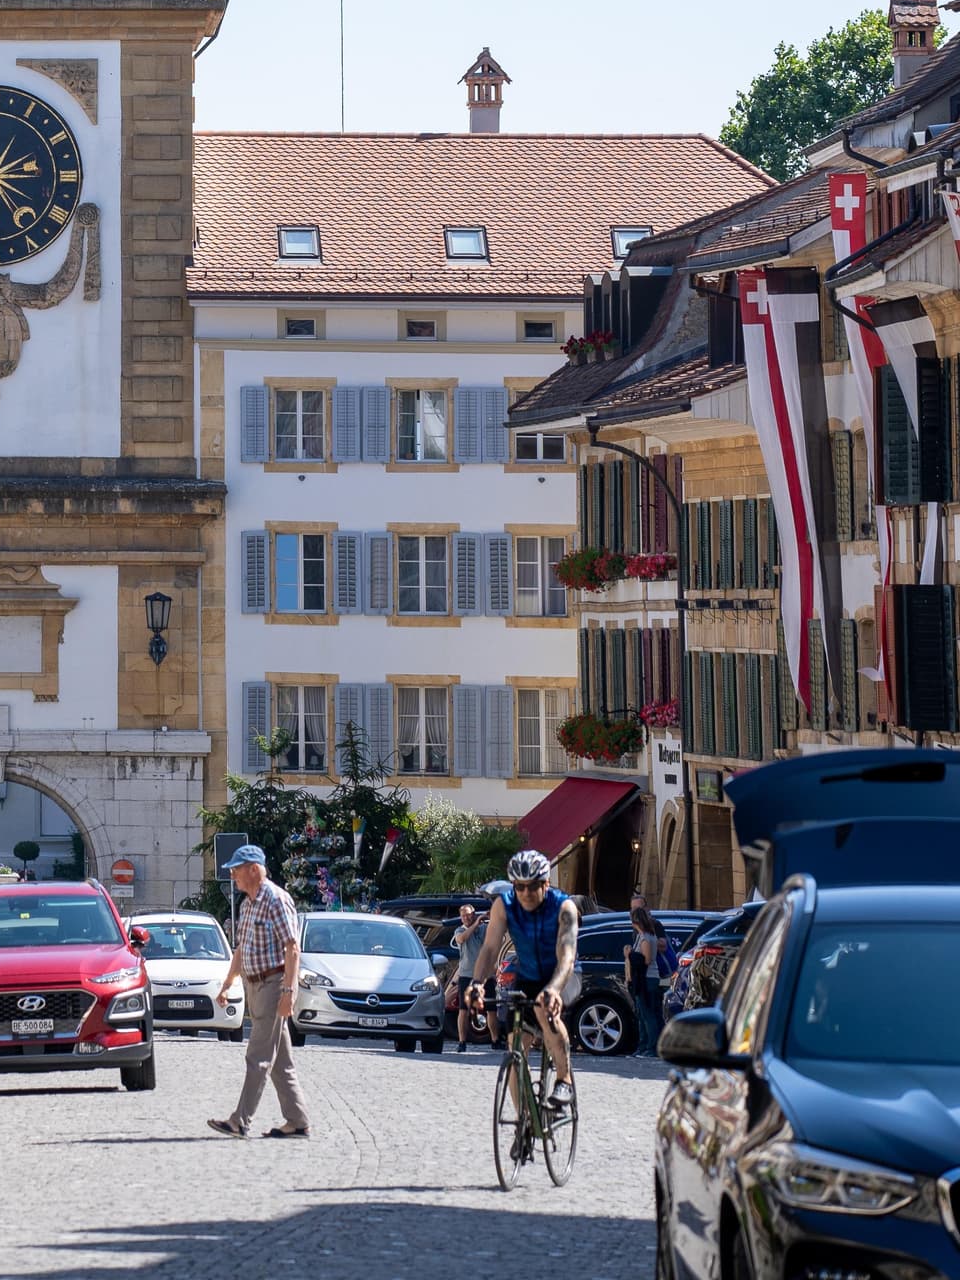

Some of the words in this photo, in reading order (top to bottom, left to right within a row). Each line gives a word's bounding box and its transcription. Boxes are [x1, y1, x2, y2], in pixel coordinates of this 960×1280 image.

[24, 100, 37, 119] I
[49, 129, 68, 146] II
[59, 170, 77, 183] III
[24, 234, 41, 255] V
